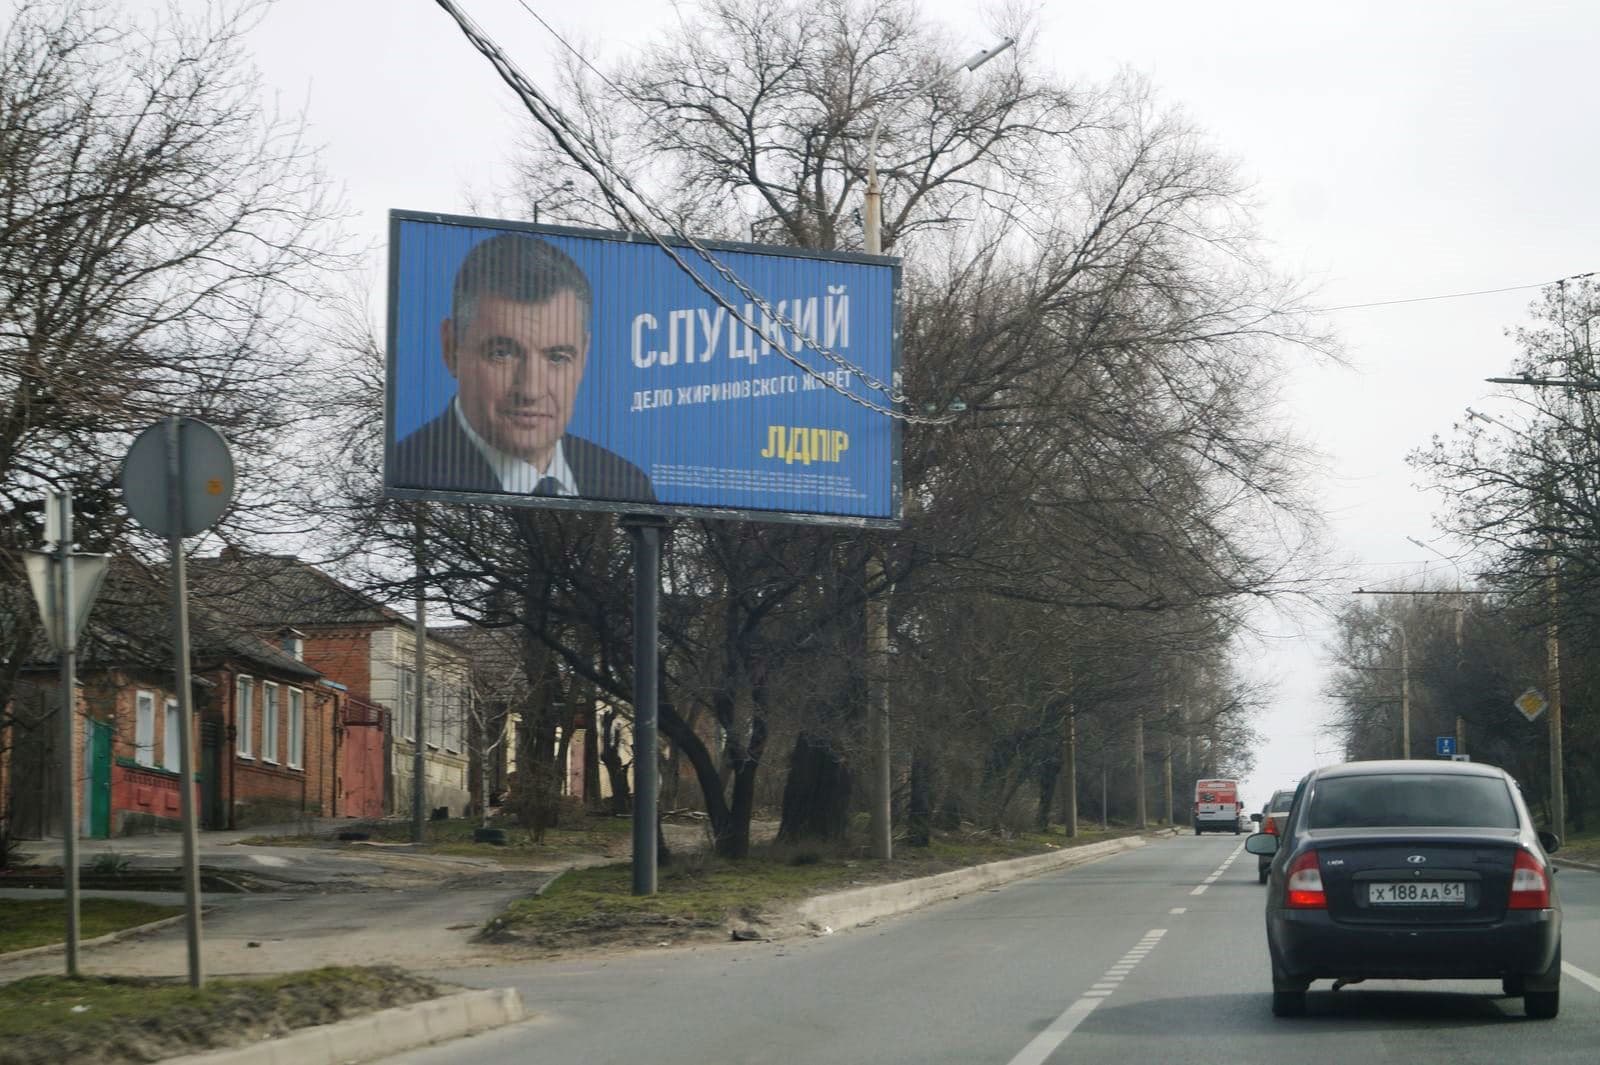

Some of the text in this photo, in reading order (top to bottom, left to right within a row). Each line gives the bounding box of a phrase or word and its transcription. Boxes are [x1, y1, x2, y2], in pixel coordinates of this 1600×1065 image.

[631, 285, 850, 369] СЛУЦКИЙ
[631, 388, 673, 412] ДЕЛО
[677, 375, 798, 405] ЖИРИНОВСКОГО
[761, 425, 849, 465] ЛДПР
